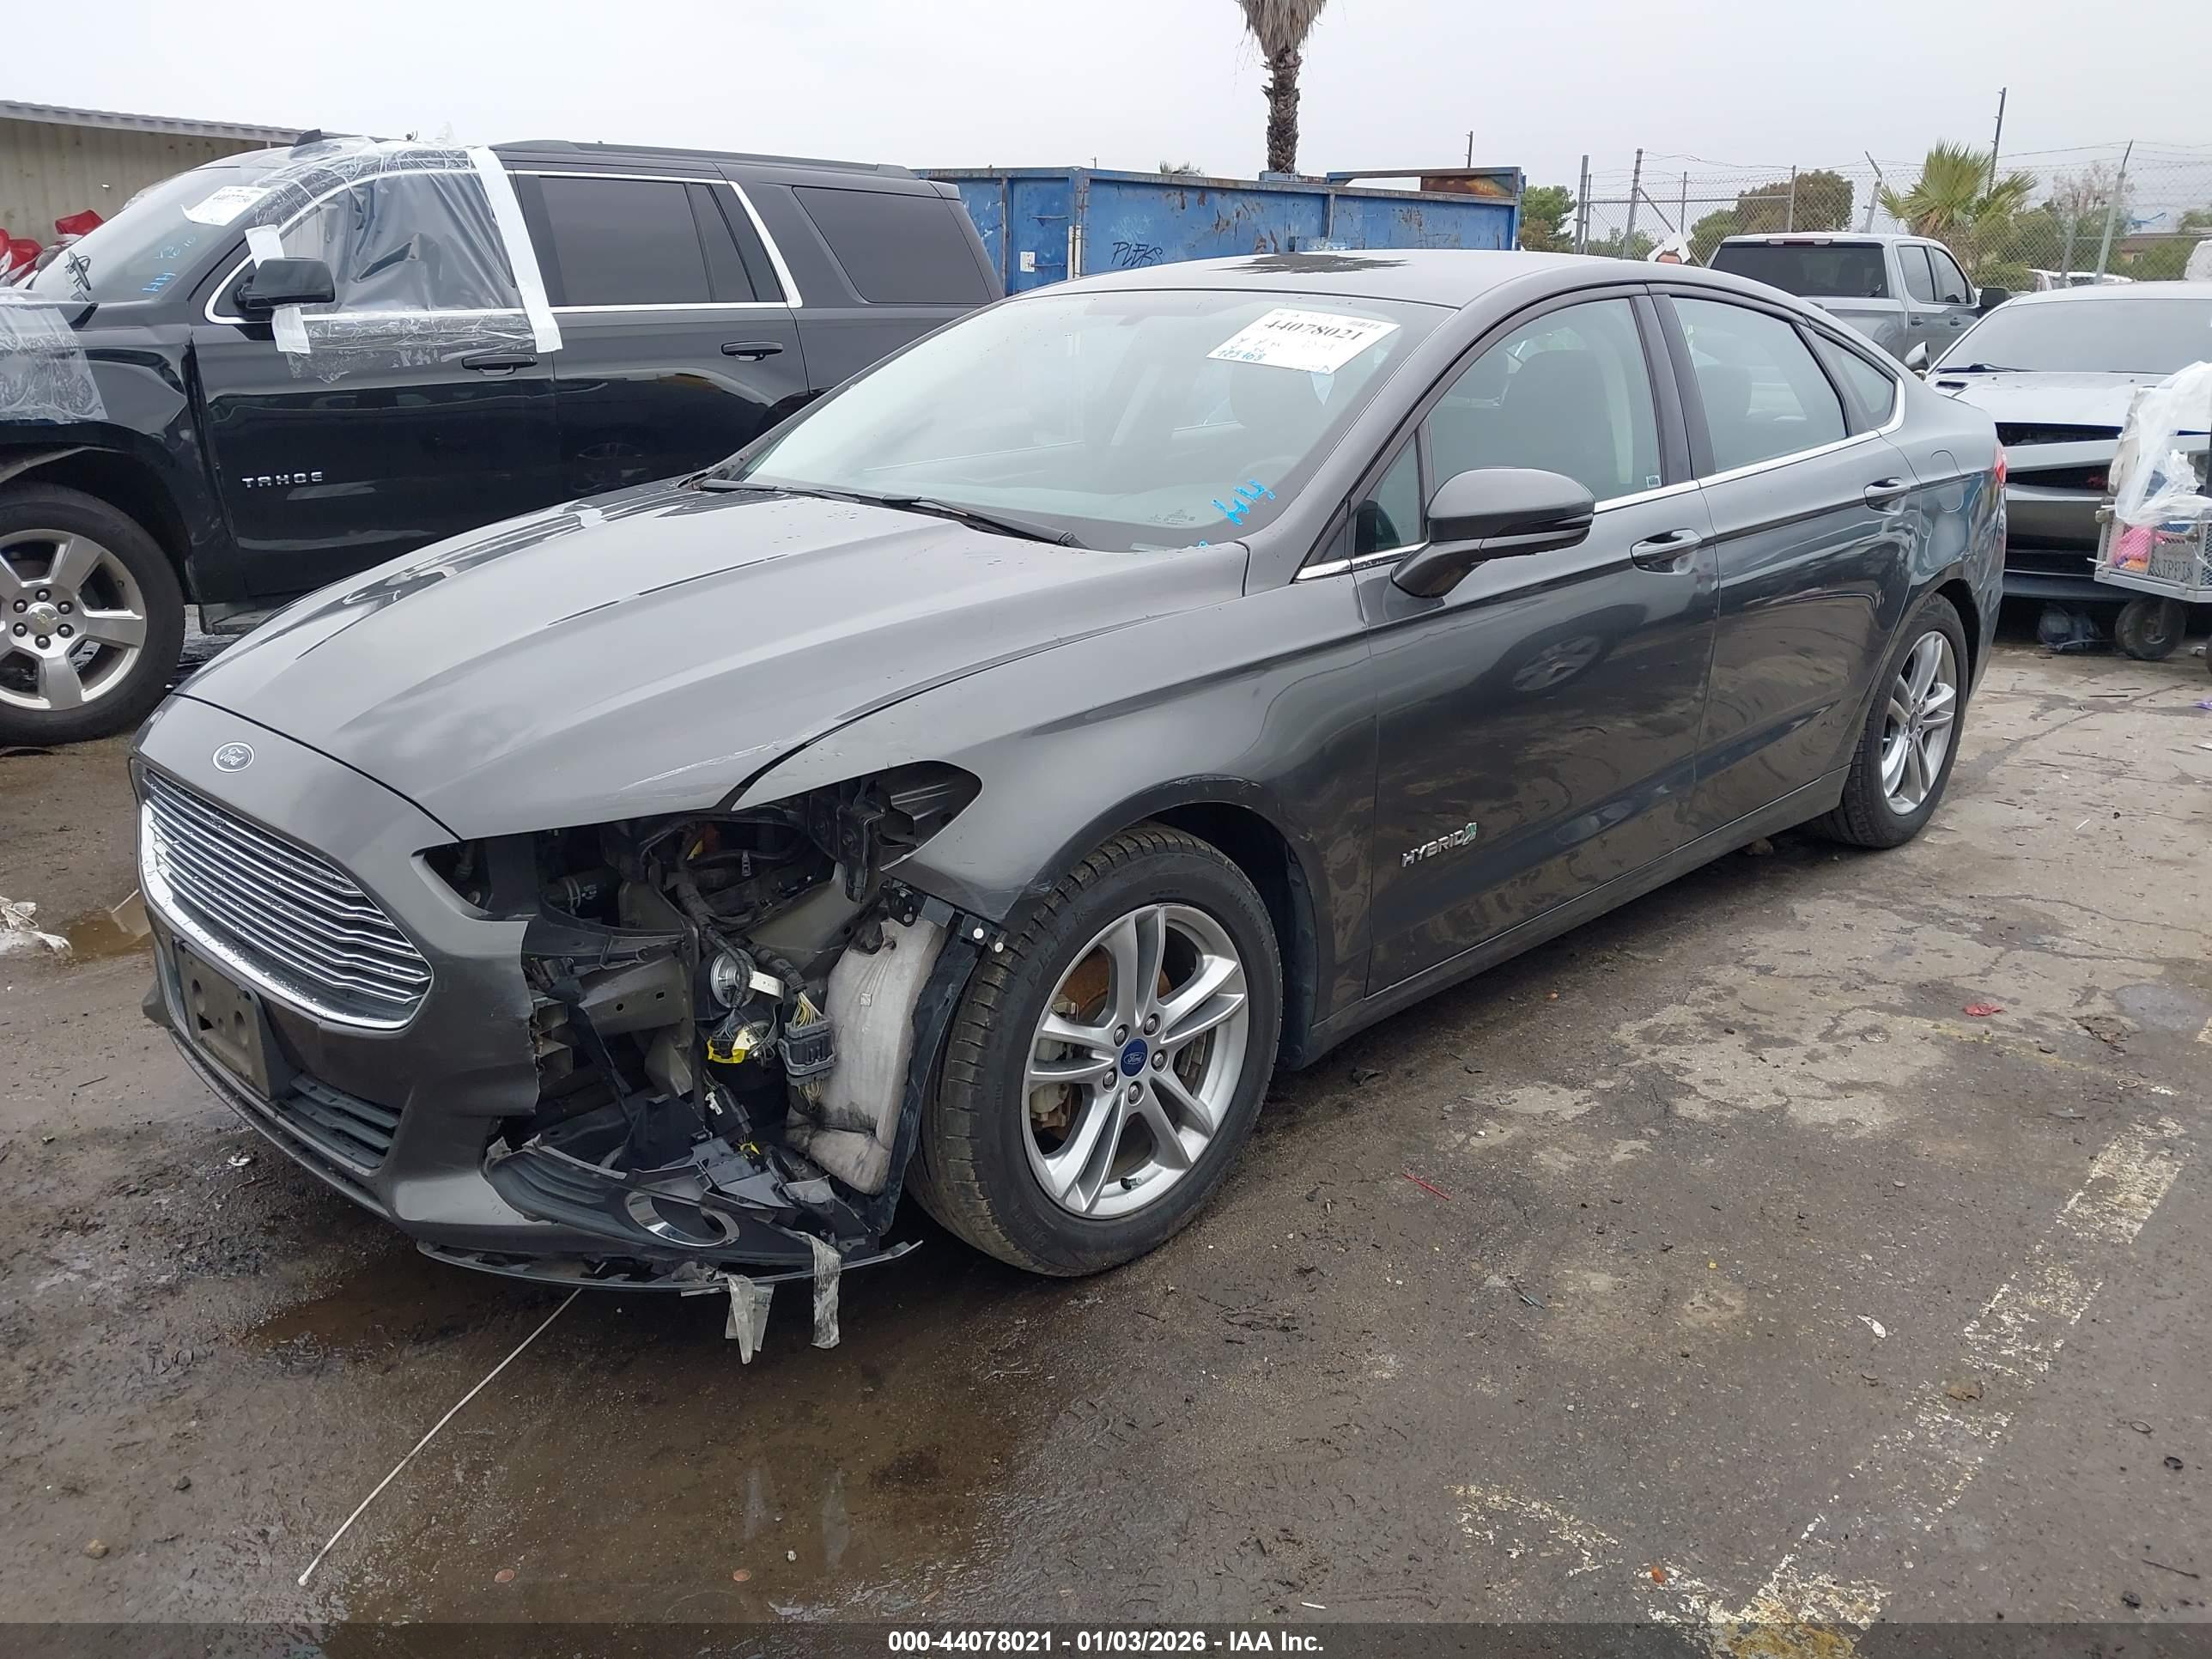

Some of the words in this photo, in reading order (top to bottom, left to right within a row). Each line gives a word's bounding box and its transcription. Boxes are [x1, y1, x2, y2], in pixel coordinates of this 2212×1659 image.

[1264, 319, 1364, 340] 44078021
[241, 471, 323, 489] TAHOE
[220, 747, 246, 766] Ford
[1401, 830, 1465, 867] HYBRID
